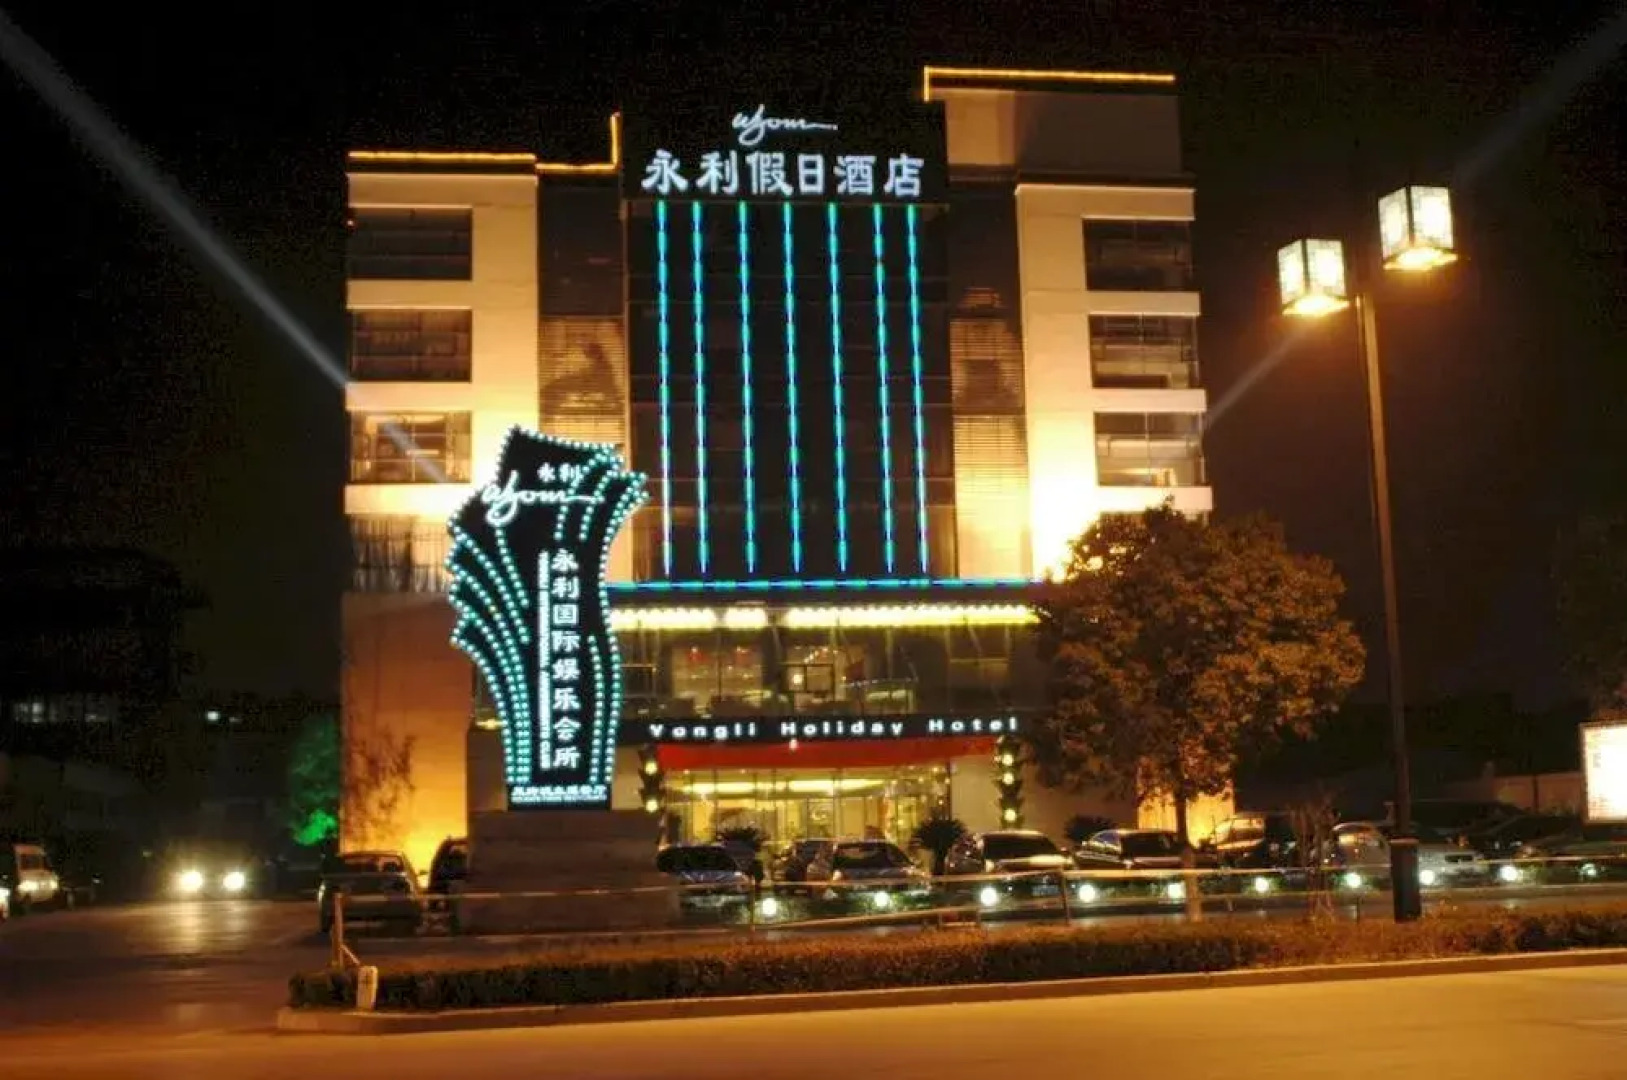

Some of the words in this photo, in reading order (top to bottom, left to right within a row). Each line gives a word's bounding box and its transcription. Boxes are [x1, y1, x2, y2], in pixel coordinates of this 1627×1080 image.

[641, 150, 924, 196] 永利假日酒店
[537, 462, 582, 483] 永利
[551, 549, 581, 769] 永利国际娱乐会所
[650, 723, 756, 740] Yongli
[780, 721, 903, 736] Holiday
[928, 717, 1018, 733] Hotel
